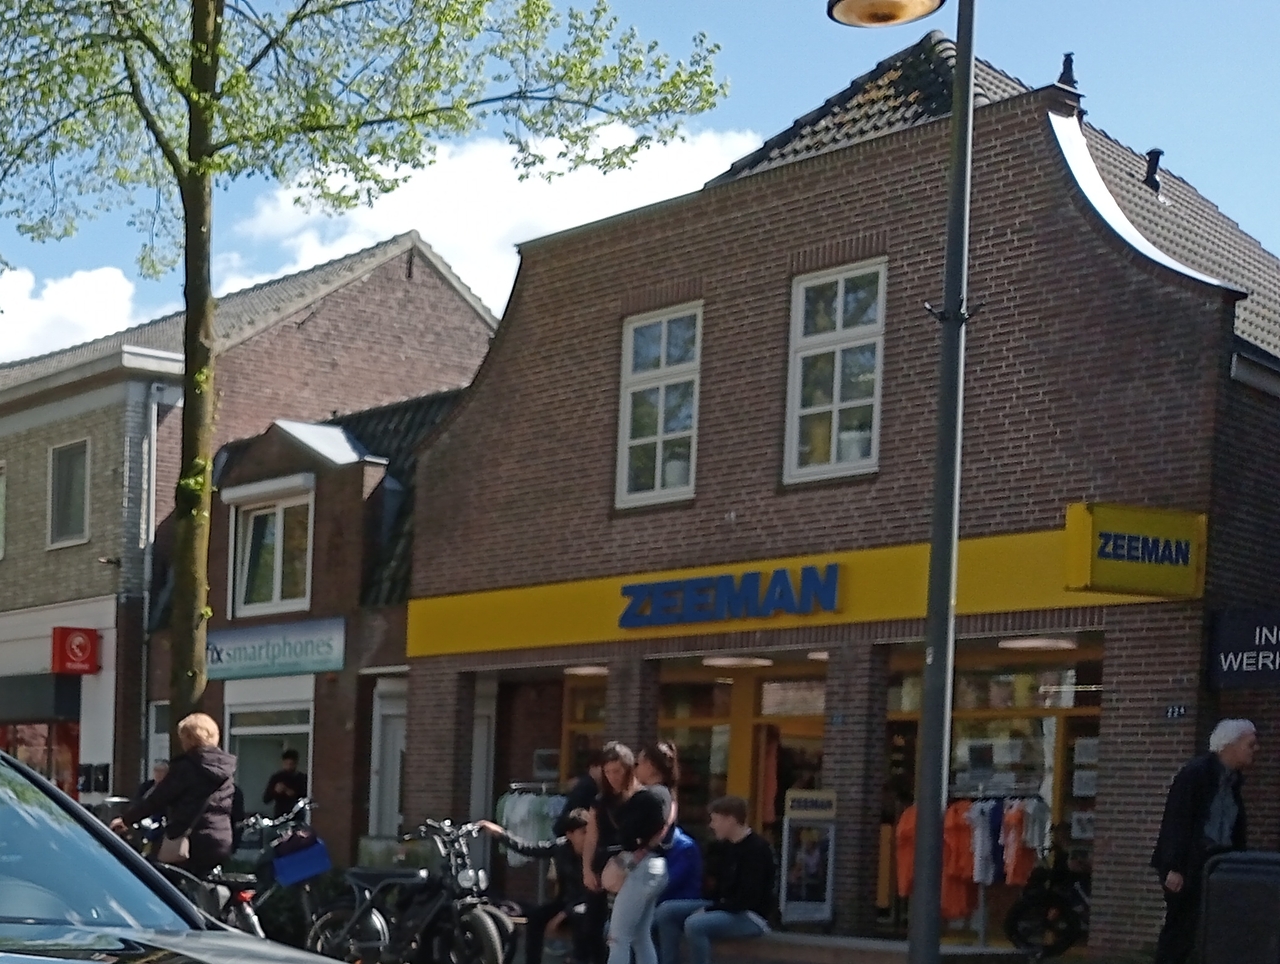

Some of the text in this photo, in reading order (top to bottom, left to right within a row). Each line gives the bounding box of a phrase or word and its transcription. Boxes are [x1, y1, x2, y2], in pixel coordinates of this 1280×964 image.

[1097, 531, 1191, 567] ZEEMAN
[618, 563, 839, 629] ZEEMAN
[1254, 626, 1280, 646] IN
